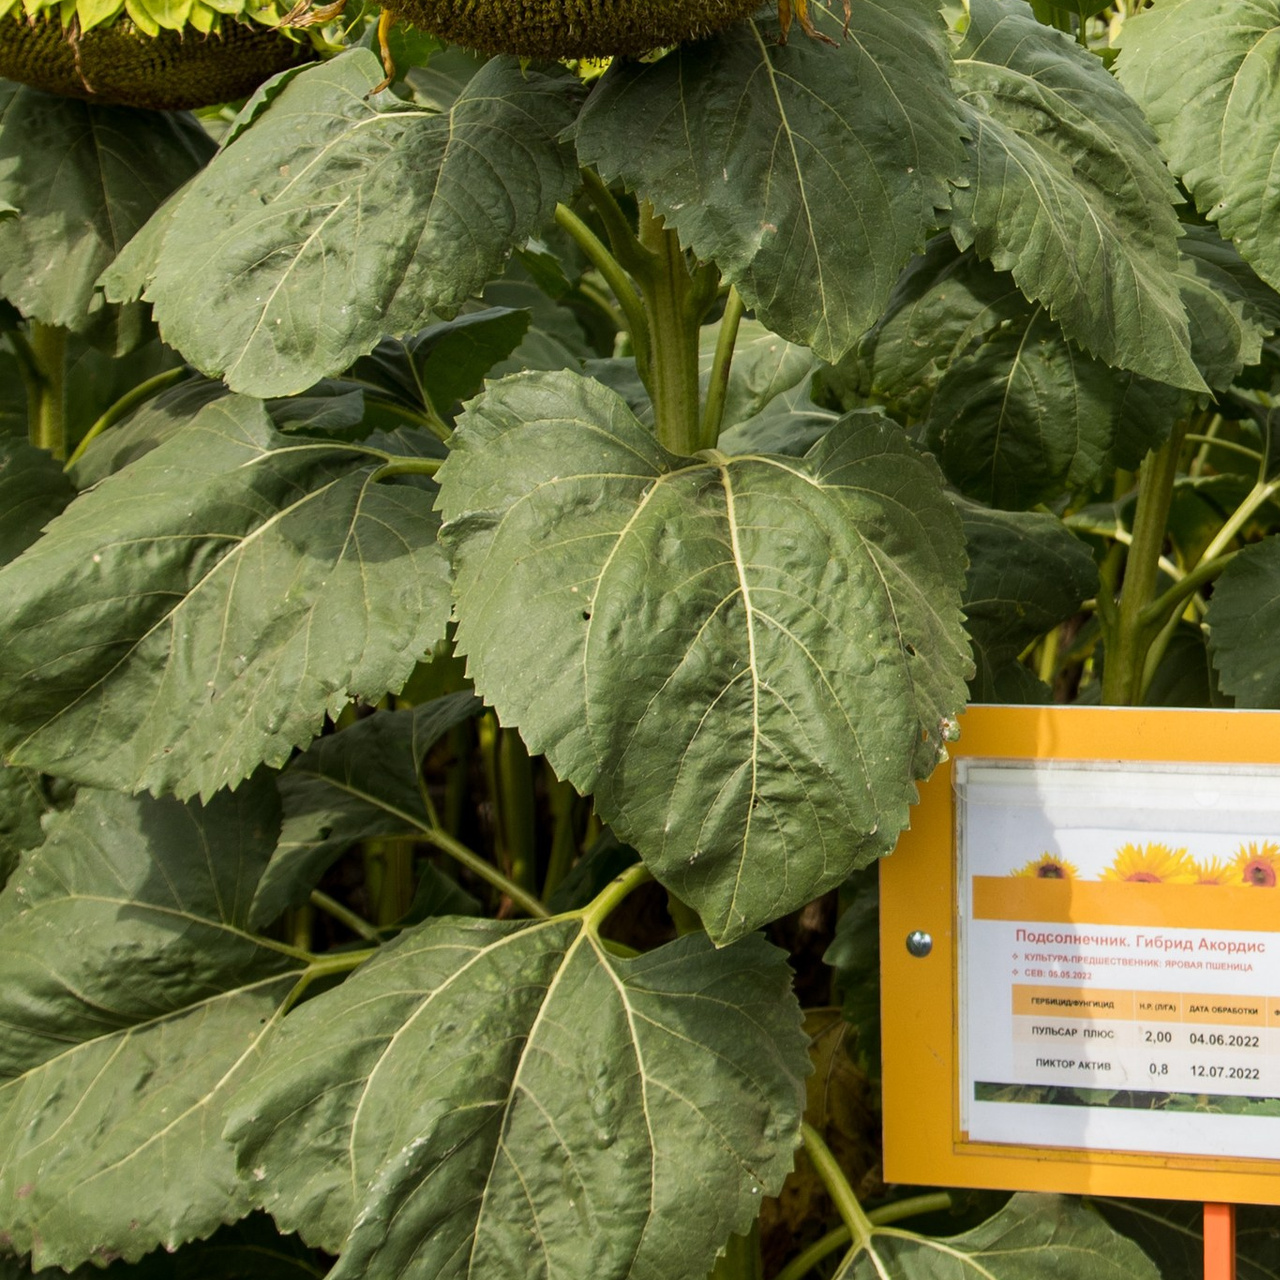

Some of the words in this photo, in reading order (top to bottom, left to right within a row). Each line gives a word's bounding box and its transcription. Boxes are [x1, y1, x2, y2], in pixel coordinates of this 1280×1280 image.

[1016, 929, 1130, 947] Подсолнечник.
[1136, 935, 1193, 952] Гибрид
[1198, 938, 1266, 954] Акордис
[1024, 953, 1162, 968] КУЛЬТУРА-ПРЕДШЕСТВЕННИК:
[1164, 960, 1203, 969] ЯРОВАЯ
[1205, 962, 1253, 972] ПШЕНИЦА
[1024, 968, 1046, 978] СЕВ:
[1048, 970, 1092, 980] 05.05.2022
[1189, 1005, 1209, 1013] ДАТА
[1212, 1005, 1258, 1015] ОБРАБОТКИ
[1032, 1026, 1077, 1037] ПУЛЬСАР
[1083, 1030, 1114, 1039] ПЛЮС
[1145, 1031, 1172, 1044] 2,00
[1189, 1033, 1259, 1048] 04.06.2022
[1036, 1059, 1075, 1069] ПИКТОР
[1078, 1060, 1111, 1070] АКТИВ
[1149, 1063, 1168, 1076] 0,8
[1190, 1065, 1260, 1080] 12.07.2022
